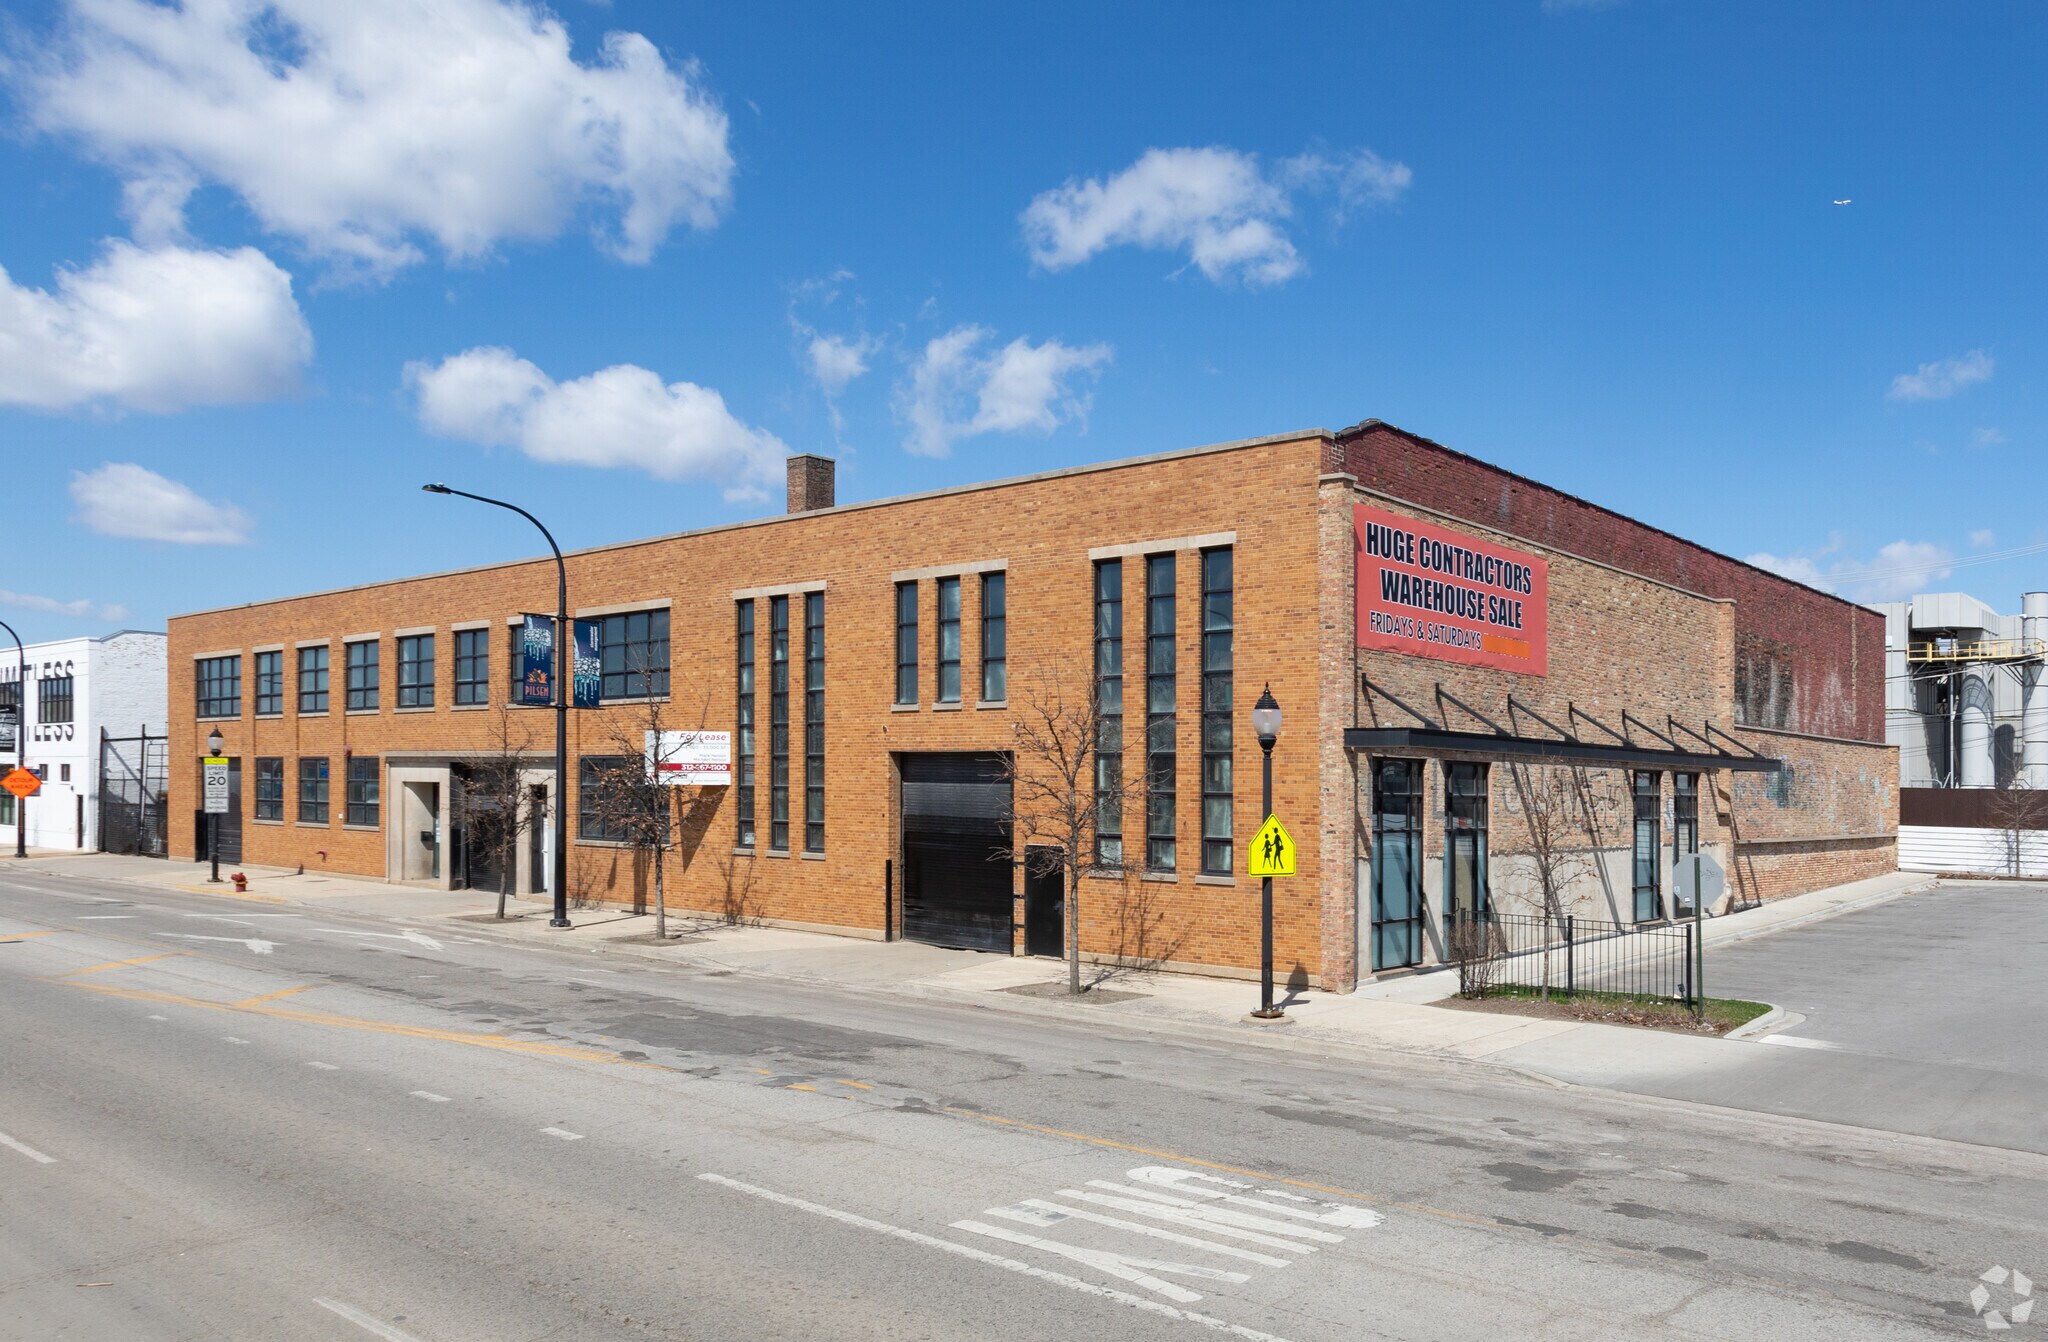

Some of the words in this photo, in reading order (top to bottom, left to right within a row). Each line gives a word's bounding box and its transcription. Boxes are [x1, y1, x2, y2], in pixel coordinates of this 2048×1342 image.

[1365, 521, 1415, 566] HUGE
[1418, 536, 1532, 595] CONTRACTORS
[1380, 568, 1485, 622] WAREHOUSE
[1489, 594, 1523, 630] SALE
[1369, 611, 1414, 638] FRIDAYS
[1416, 620, 1425, 640] &
[1427, 622, 1482, 651] SATURDAYS
[525, 685, 549, 697] PILSEN
[699, 733, 727, 741] Lease
[207, 776, 226, 786] 20
